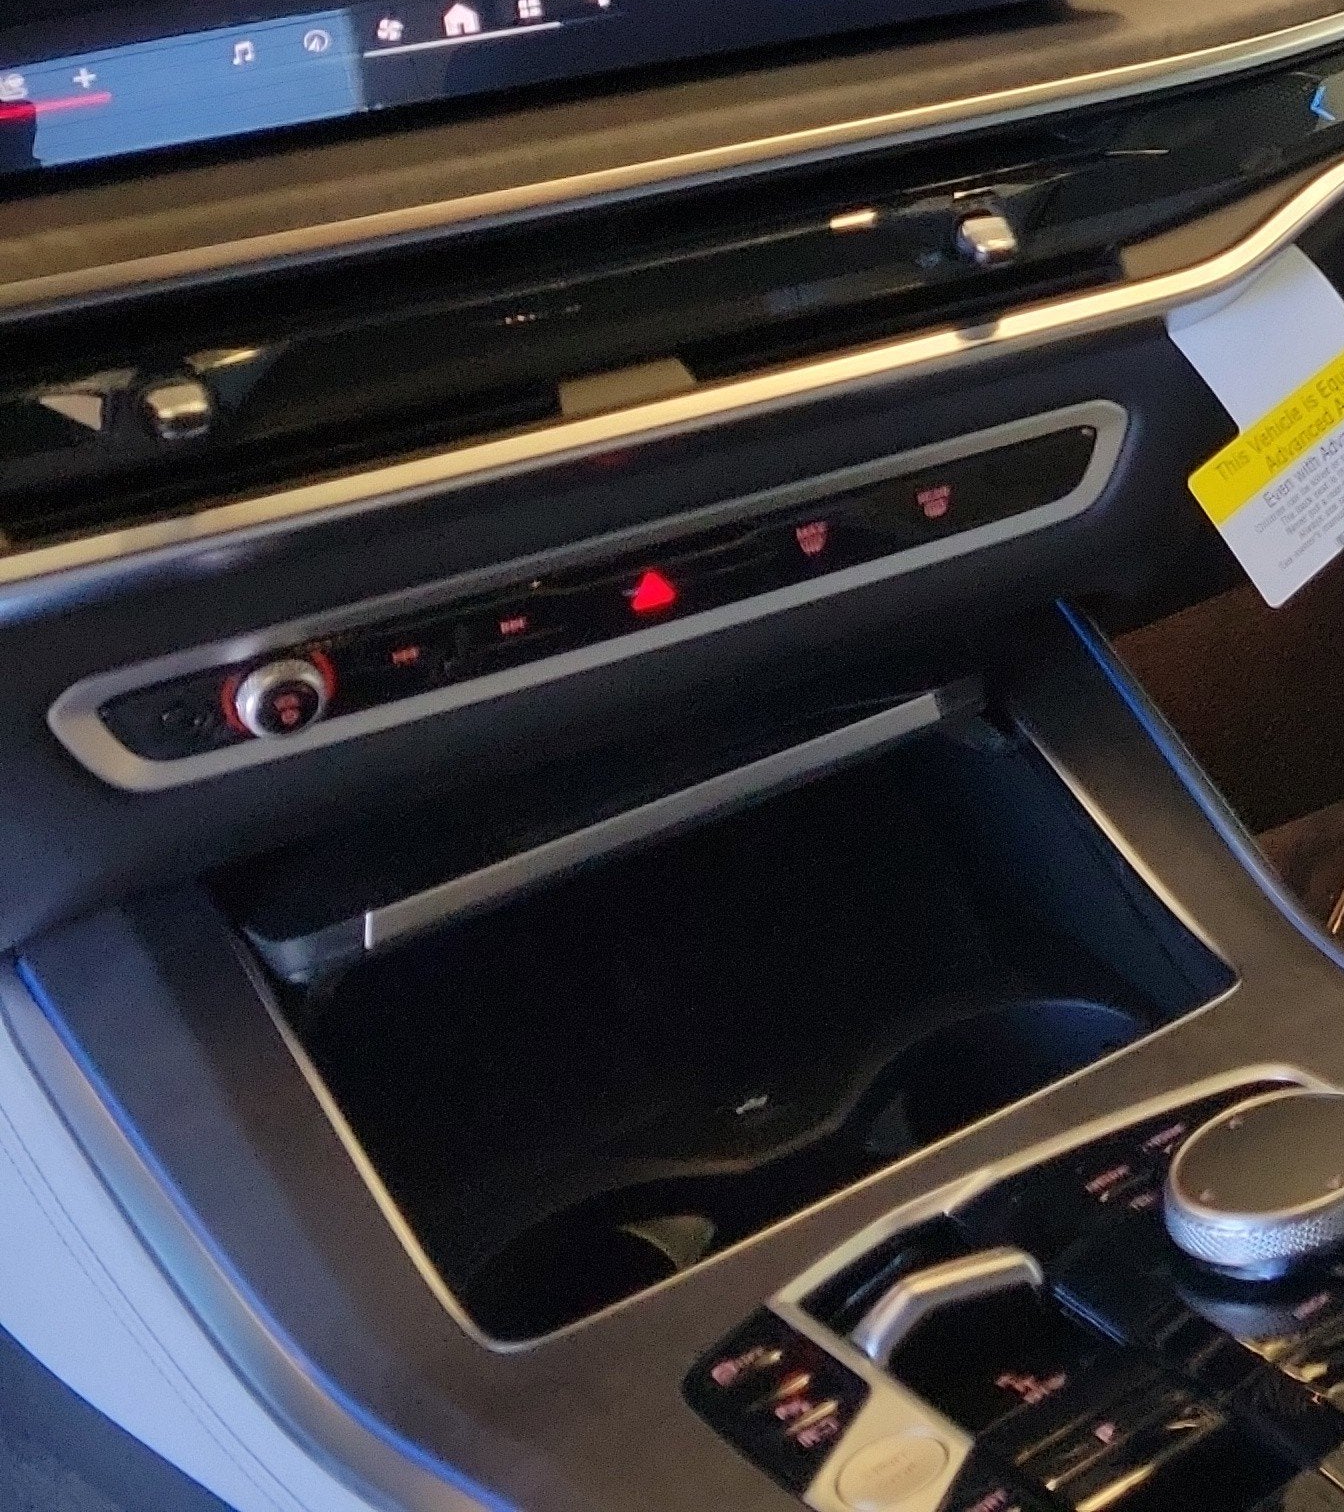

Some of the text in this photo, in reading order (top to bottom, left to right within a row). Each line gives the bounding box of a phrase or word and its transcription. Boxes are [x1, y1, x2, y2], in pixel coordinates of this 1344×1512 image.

[1216, 448, 1252, 481] This
[1246, 404, 1303, 454] Vehicle
[1302, 395, 1320, 417] is
[1264, 411, 1336, 473] Advanced
[1262, 478, 1295, 509] Even
[1294, 456, 1323, 484] with
